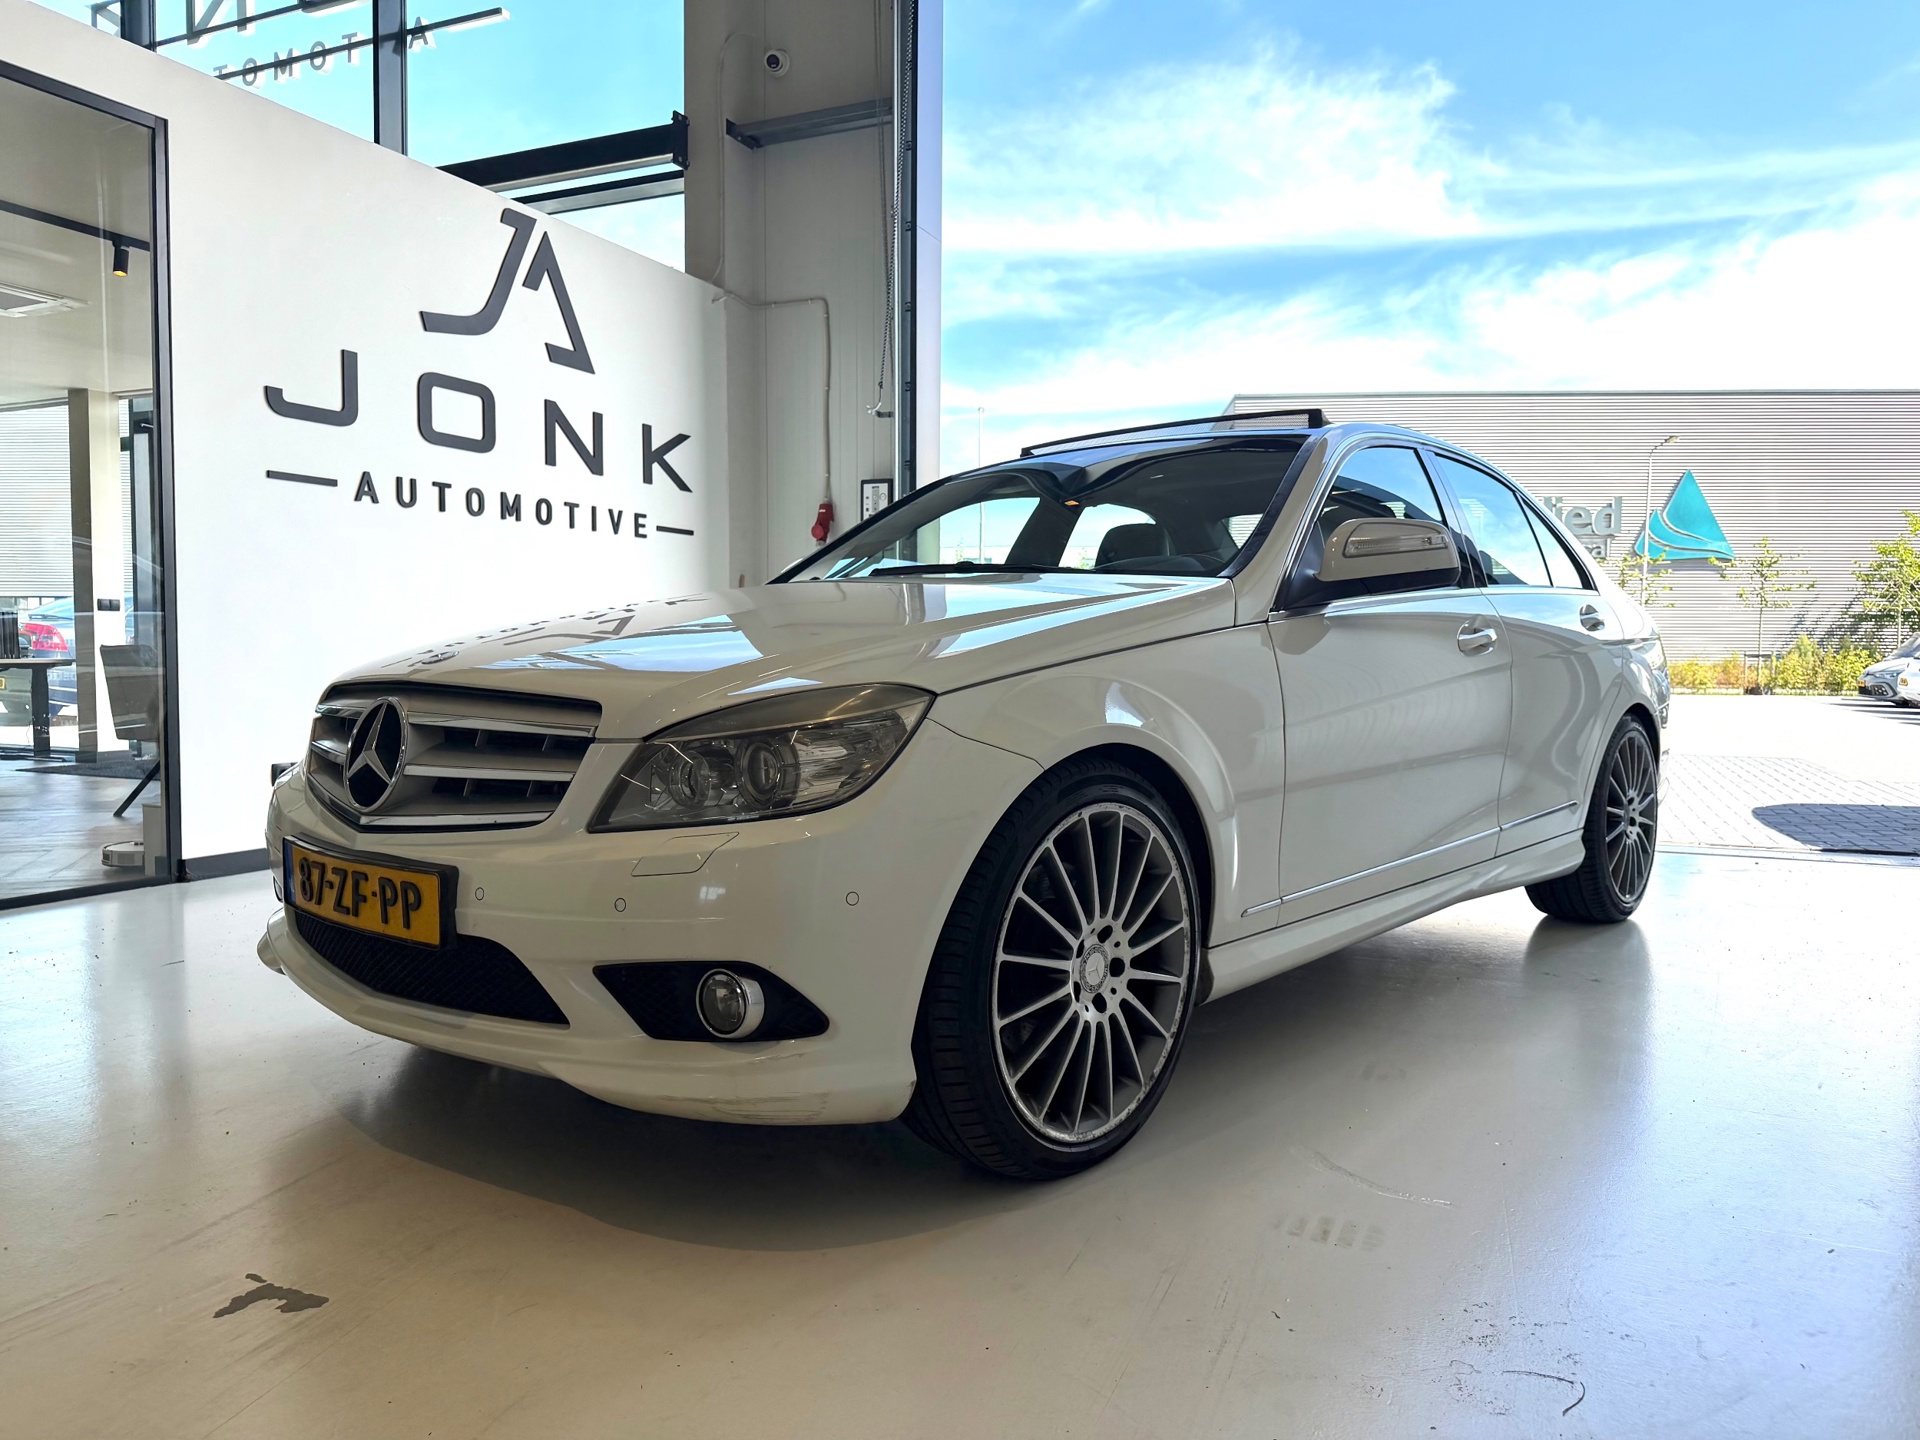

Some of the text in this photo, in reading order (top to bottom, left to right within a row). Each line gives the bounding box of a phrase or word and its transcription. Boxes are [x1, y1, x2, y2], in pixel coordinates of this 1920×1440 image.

[264, 349, 693, 494] JONK
[354, 471, 649, 539] AUTOMOTIVE
[299, 856, 422, 930] 87-ZF-PP
